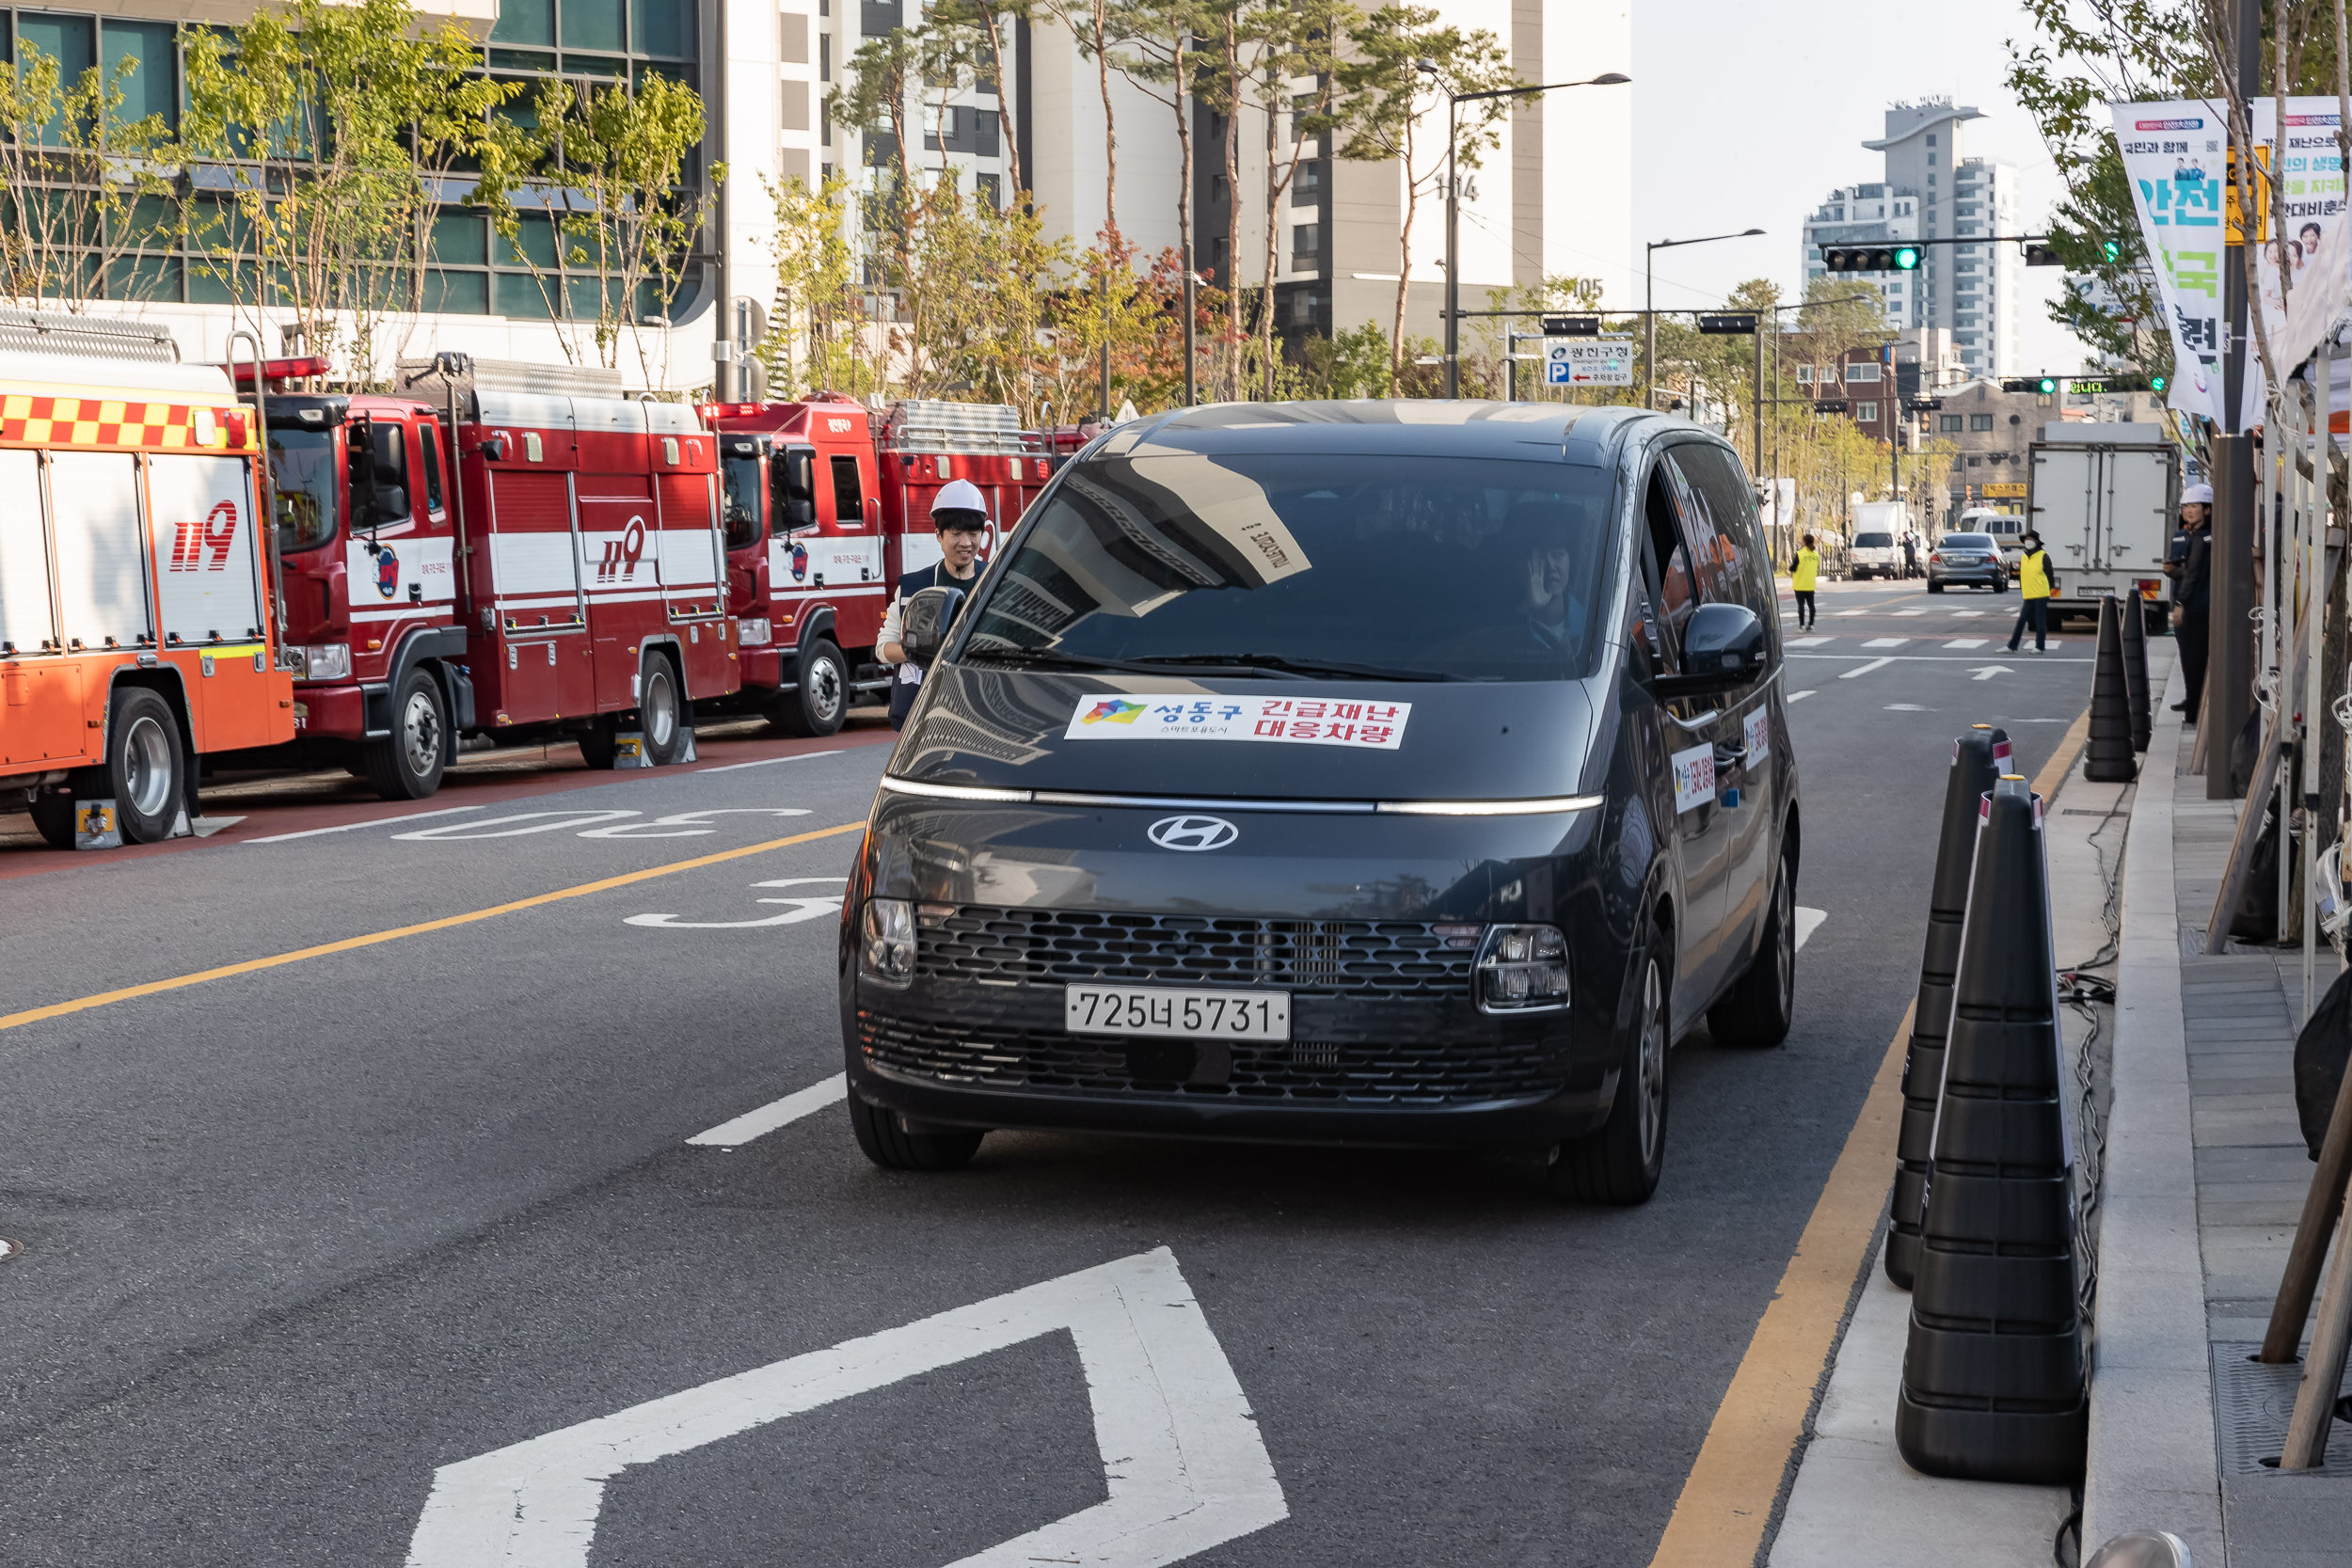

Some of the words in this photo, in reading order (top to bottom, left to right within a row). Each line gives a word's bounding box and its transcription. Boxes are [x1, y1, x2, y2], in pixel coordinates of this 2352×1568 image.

[2162, 140, 2188, 153] 함께
[2288, 136, 2336, 149] 재난으로
[1569, 345, 1629, 358] 광진구청
[169, 499, 237, 572] 119
[596, 515, 645, 583] 119
[1153, 701, 1243, 723] 성동구
[1261, 700, 1400, 723] 긴급재난
[1253, 719, 1394, 744] 대응차량
[622, 877, 852, 929] 3
[1080, 993, 1172, 1029] 725너
[1183, 997, 1269, 1034] 5731
